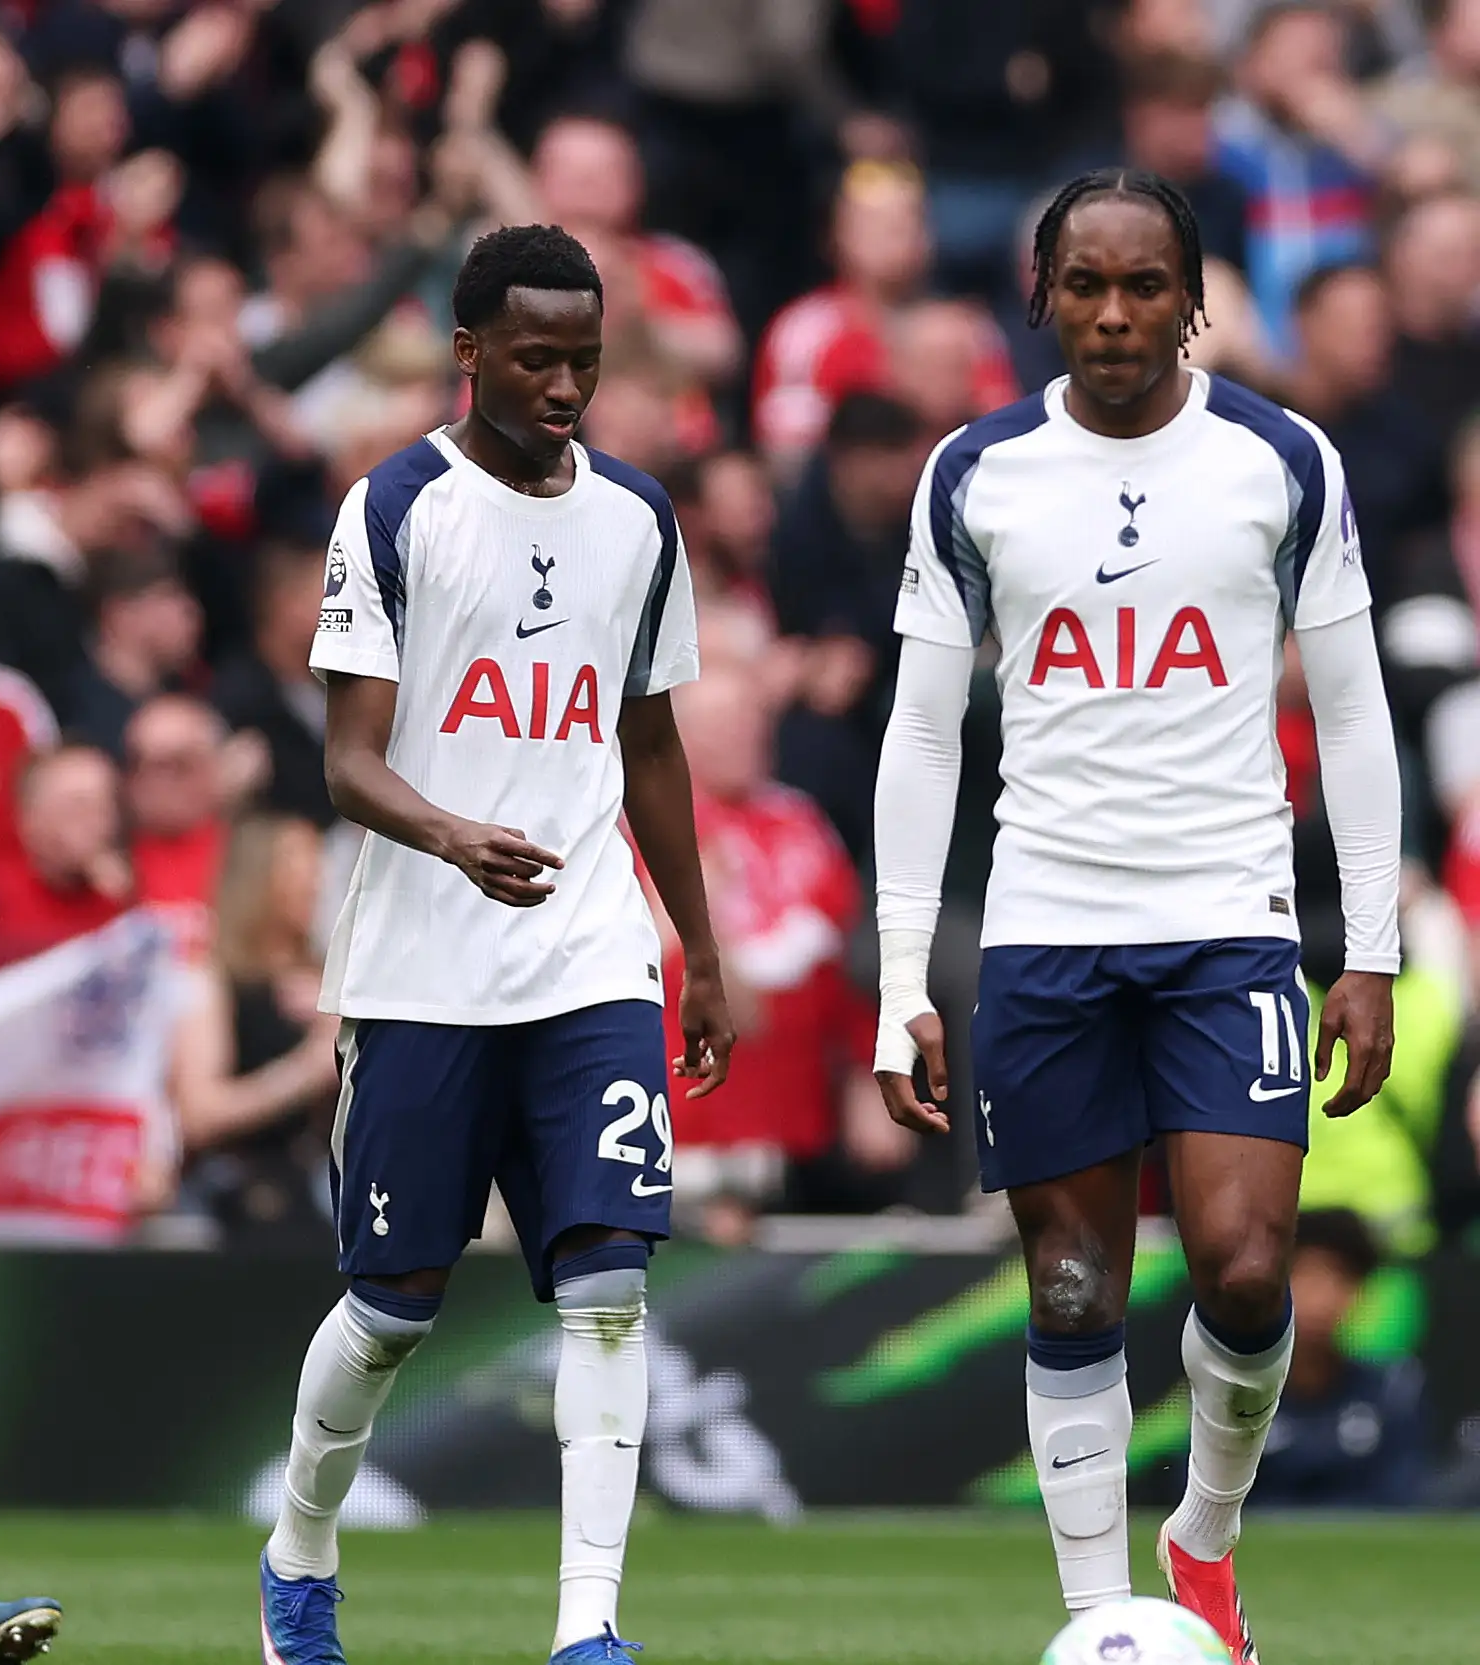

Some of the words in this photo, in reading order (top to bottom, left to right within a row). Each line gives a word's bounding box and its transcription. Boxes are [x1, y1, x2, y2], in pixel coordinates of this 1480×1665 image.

[317, 621, 352, 632] acism
[319, 610, 347, 622] oom
[1029, 606, 1228, 689] AIA
[440, 657, 604, 743] AIA
[1248, 991, 1302, 1083] 11
[597, 1079, 673, 1173] 29
